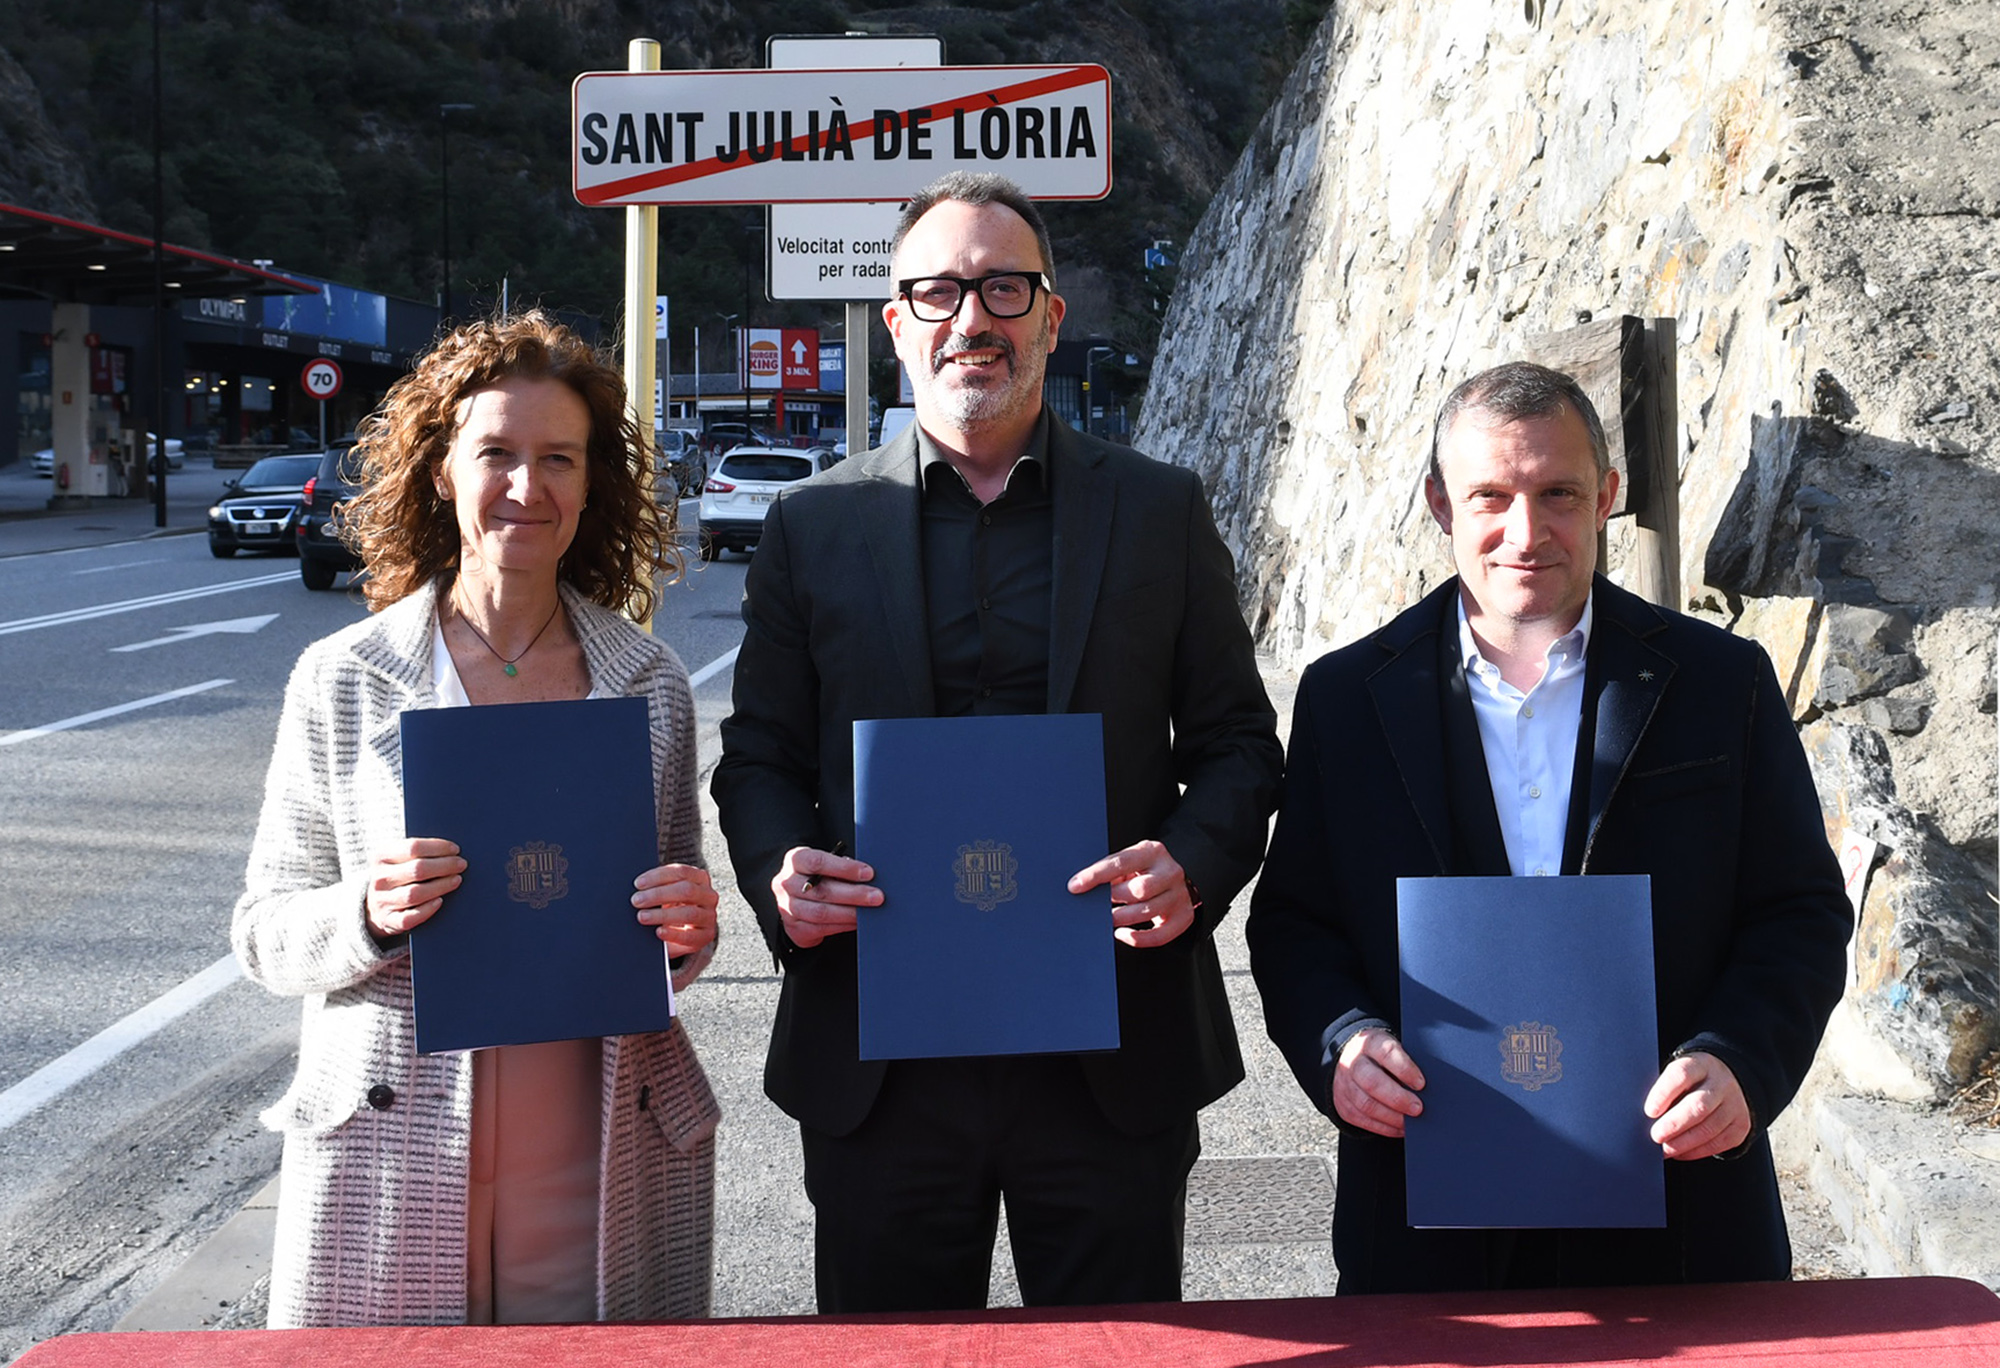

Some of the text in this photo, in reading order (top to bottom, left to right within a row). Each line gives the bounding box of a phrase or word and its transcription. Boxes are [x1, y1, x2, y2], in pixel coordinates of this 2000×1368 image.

[582, 94, 1097, 165] SANT JULIÀ DE LÒRIA
[777, 237, 893, 254] Velocitat contr
[818, 263, 844, 281] per
[200, 298, 246, 321] OLYMPIA
[262, 333, 288, 348] OUTLET
[750, 351, 779, 360] BURGER
[750, 359, 779, 370] KING
[785, 367, 792, 376] 3
[312, 373, 333, 386] 70
